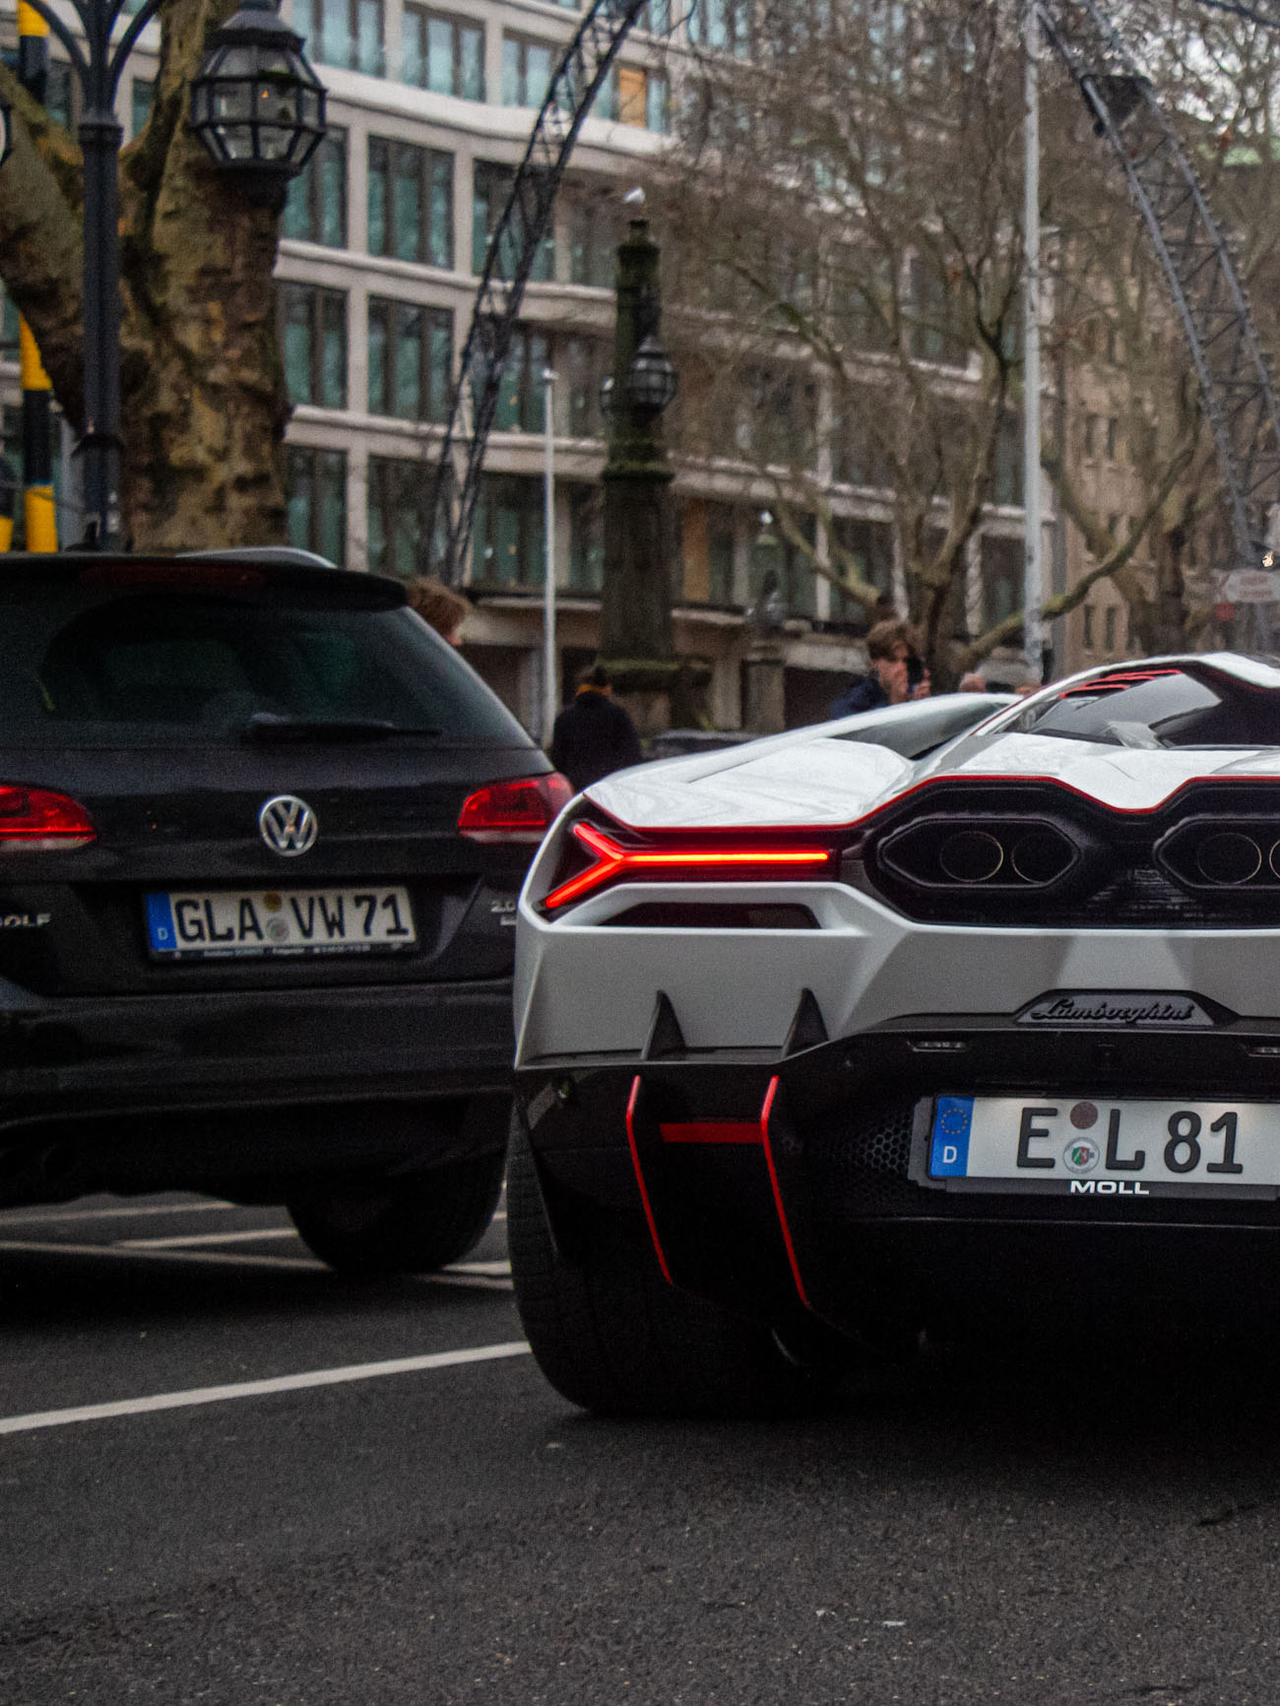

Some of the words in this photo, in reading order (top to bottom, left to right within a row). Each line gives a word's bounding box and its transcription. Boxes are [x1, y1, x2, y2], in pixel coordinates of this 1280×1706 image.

[0, 913, 51, 927] OLF
[174, 898, 264, 942] GLA
[290, 896, 346, 939] VW
[353, 894, 409, 936] 71
[1030, 998, 1195, 1024] Lamborghini
[1016, 1106, 1058, 1169] E
[1105, 1108, 1146, 1171] L
[1163, 1111, 1243, 1174] 81
[942, 1145, 957, 1164] D
[1070, 1180, 1150, 1195] MOLL
